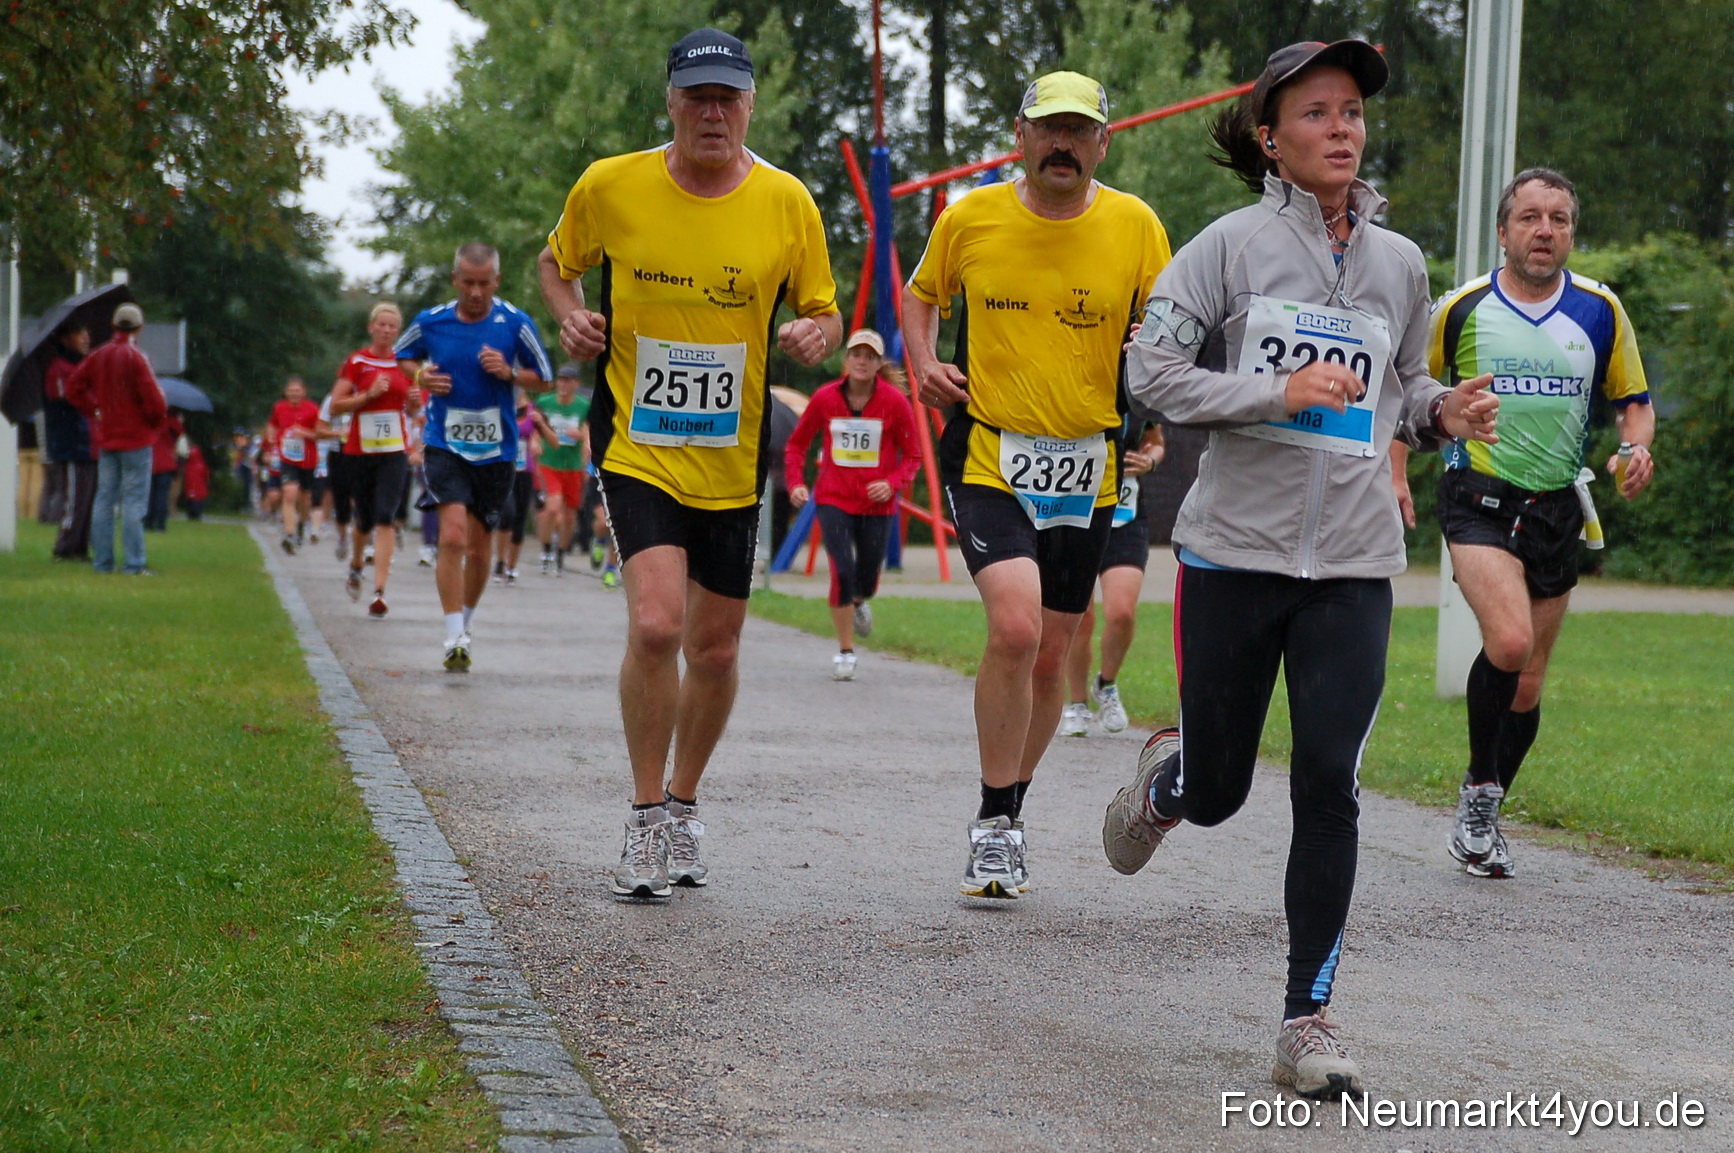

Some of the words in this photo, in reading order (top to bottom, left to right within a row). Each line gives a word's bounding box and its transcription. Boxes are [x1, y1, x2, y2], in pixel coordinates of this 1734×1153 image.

[633, 268, 694, 288] Norbert
[722, 266, 742, 275] TSV
[1072, 288, 1090, 296] TSV
[985, 298, 1029, 311] Heinz
[1296, 312, 1352, 333] BOCK
[668, 348, 716, 361] BOCK
[1491, 358, 1555, 373] TEAM
[642, 367, 734, 410] 2513
[1491, 374, 1585, 397] BOCK
[374, 423, 391, 438] 79
[451, 423, 498, 442] 2232
[659, 416, 715, 433] Norbert
[841, 432, 870, 450] 516
[1010, 453, 1095, 493] 2324
